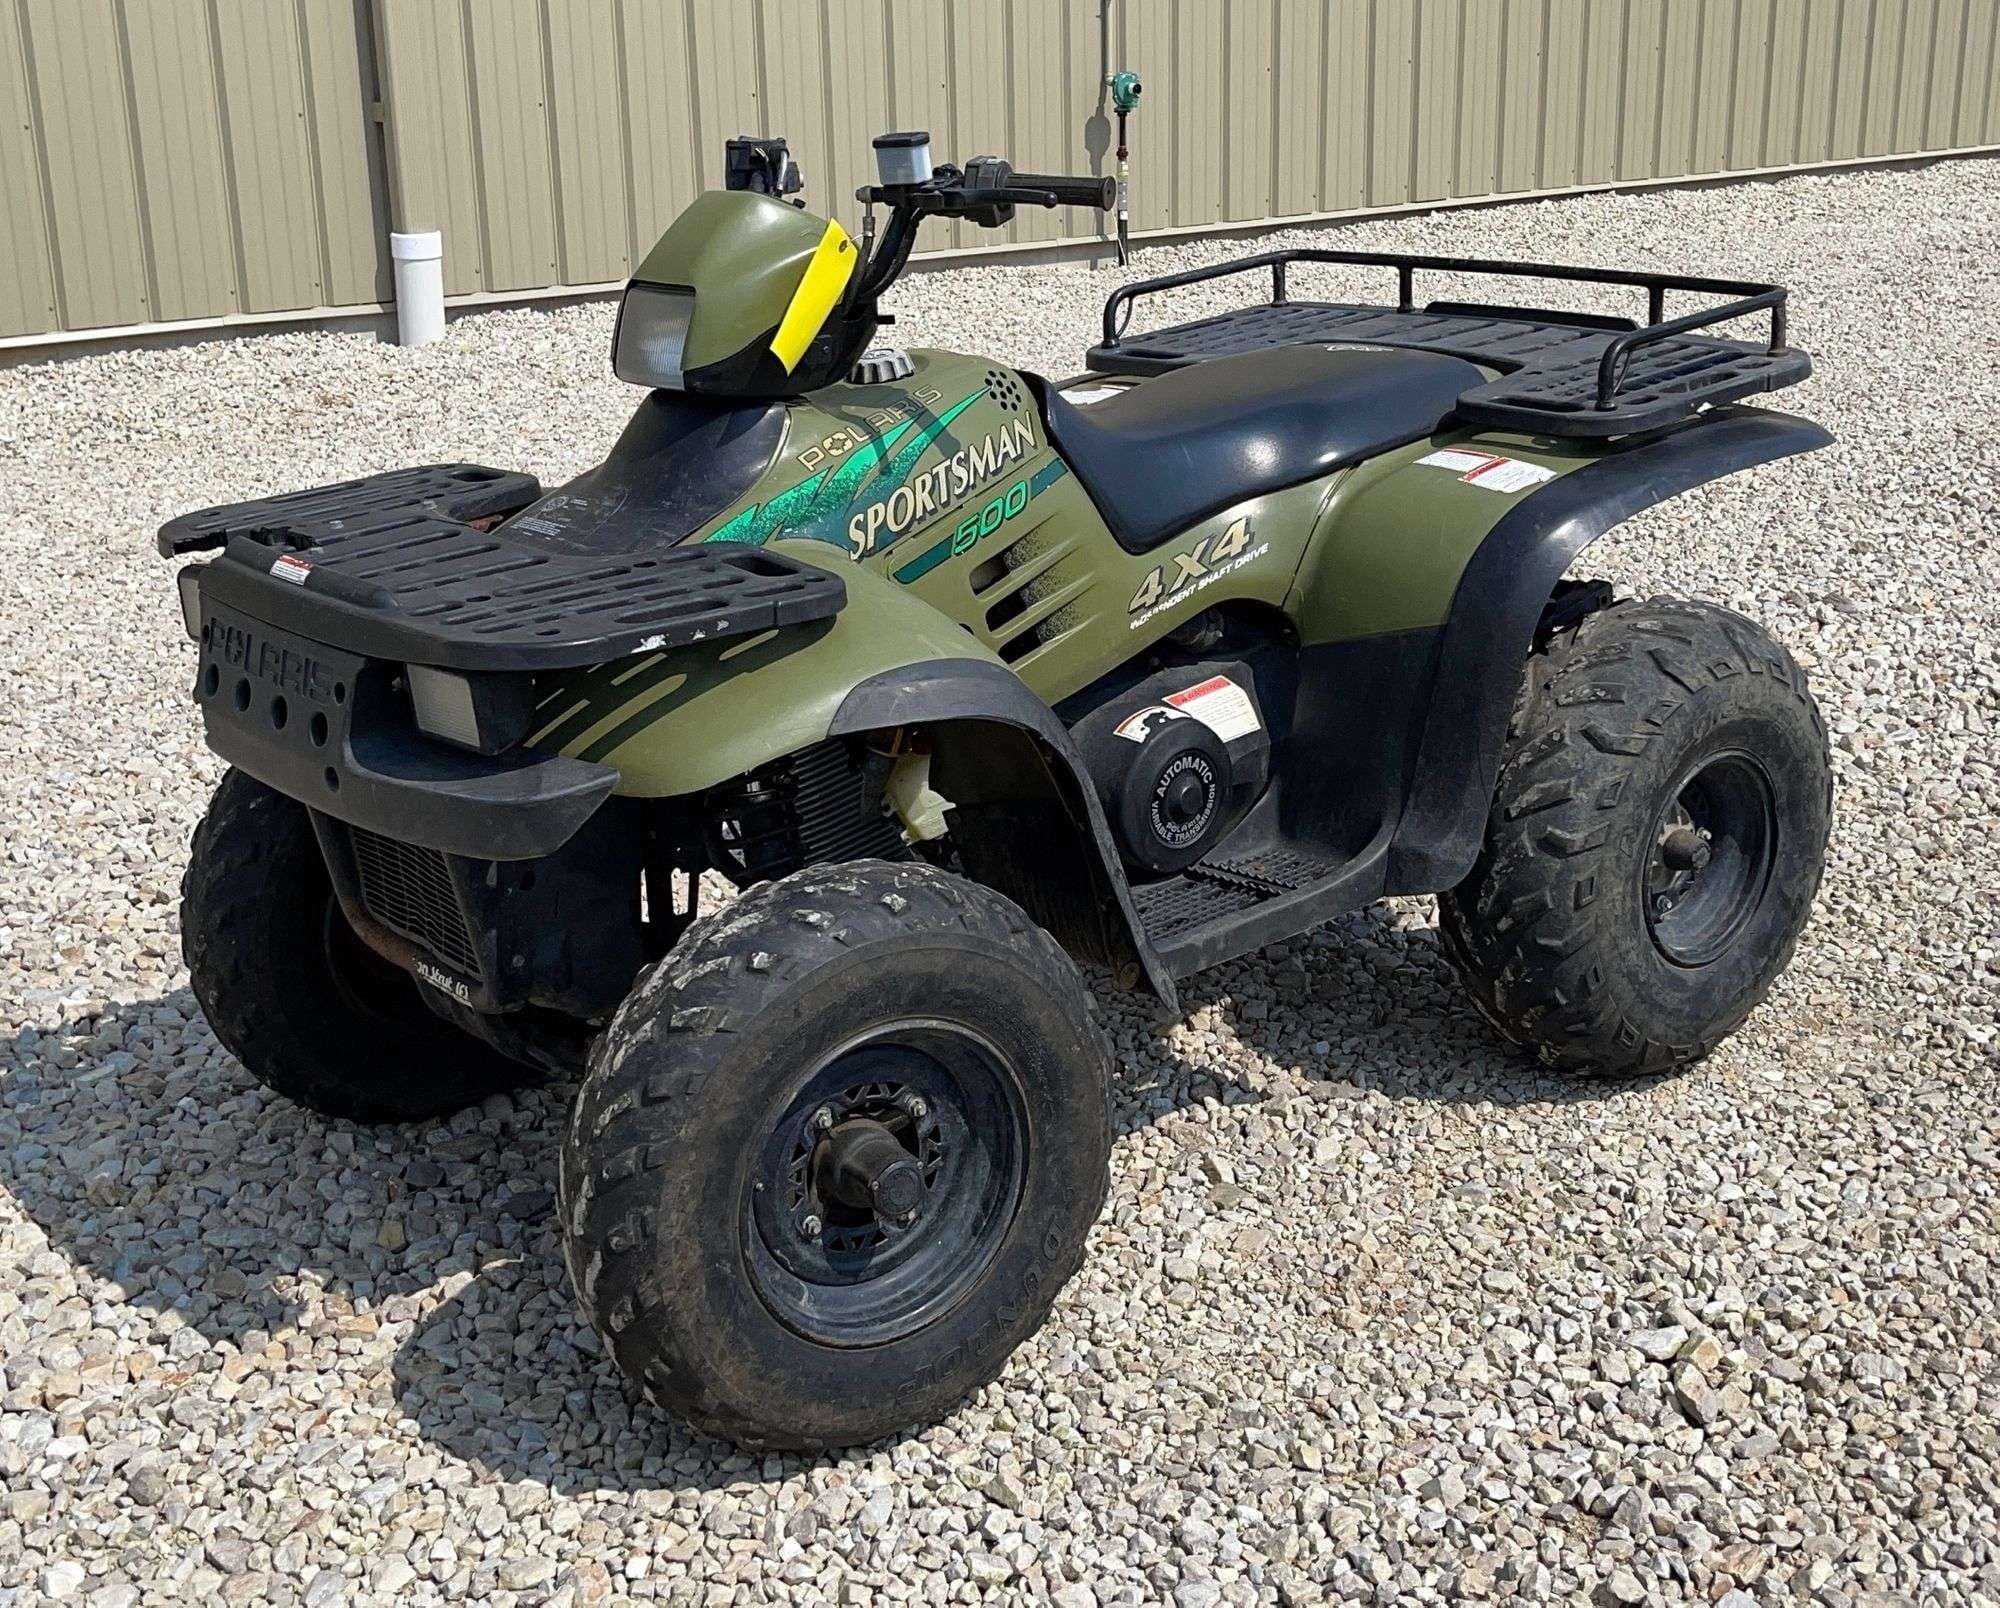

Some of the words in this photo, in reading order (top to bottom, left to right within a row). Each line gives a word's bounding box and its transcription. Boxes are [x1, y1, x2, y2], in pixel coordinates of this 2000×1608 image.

[796, 384, 943, 472] POLARIS
[849, 410, 1038, 563] SPORTSMAN
[952, 479, 1030, 556] 500
[1127, 515, 1255, 615] 4X4
[1197, 562, 1233, 591] SHAFT
[1233, 542, 1270, 570] DRIVE
[208, 616, 334, 704] POLARIS
[1156, 756, 1213, 798] AUTOMATIC
